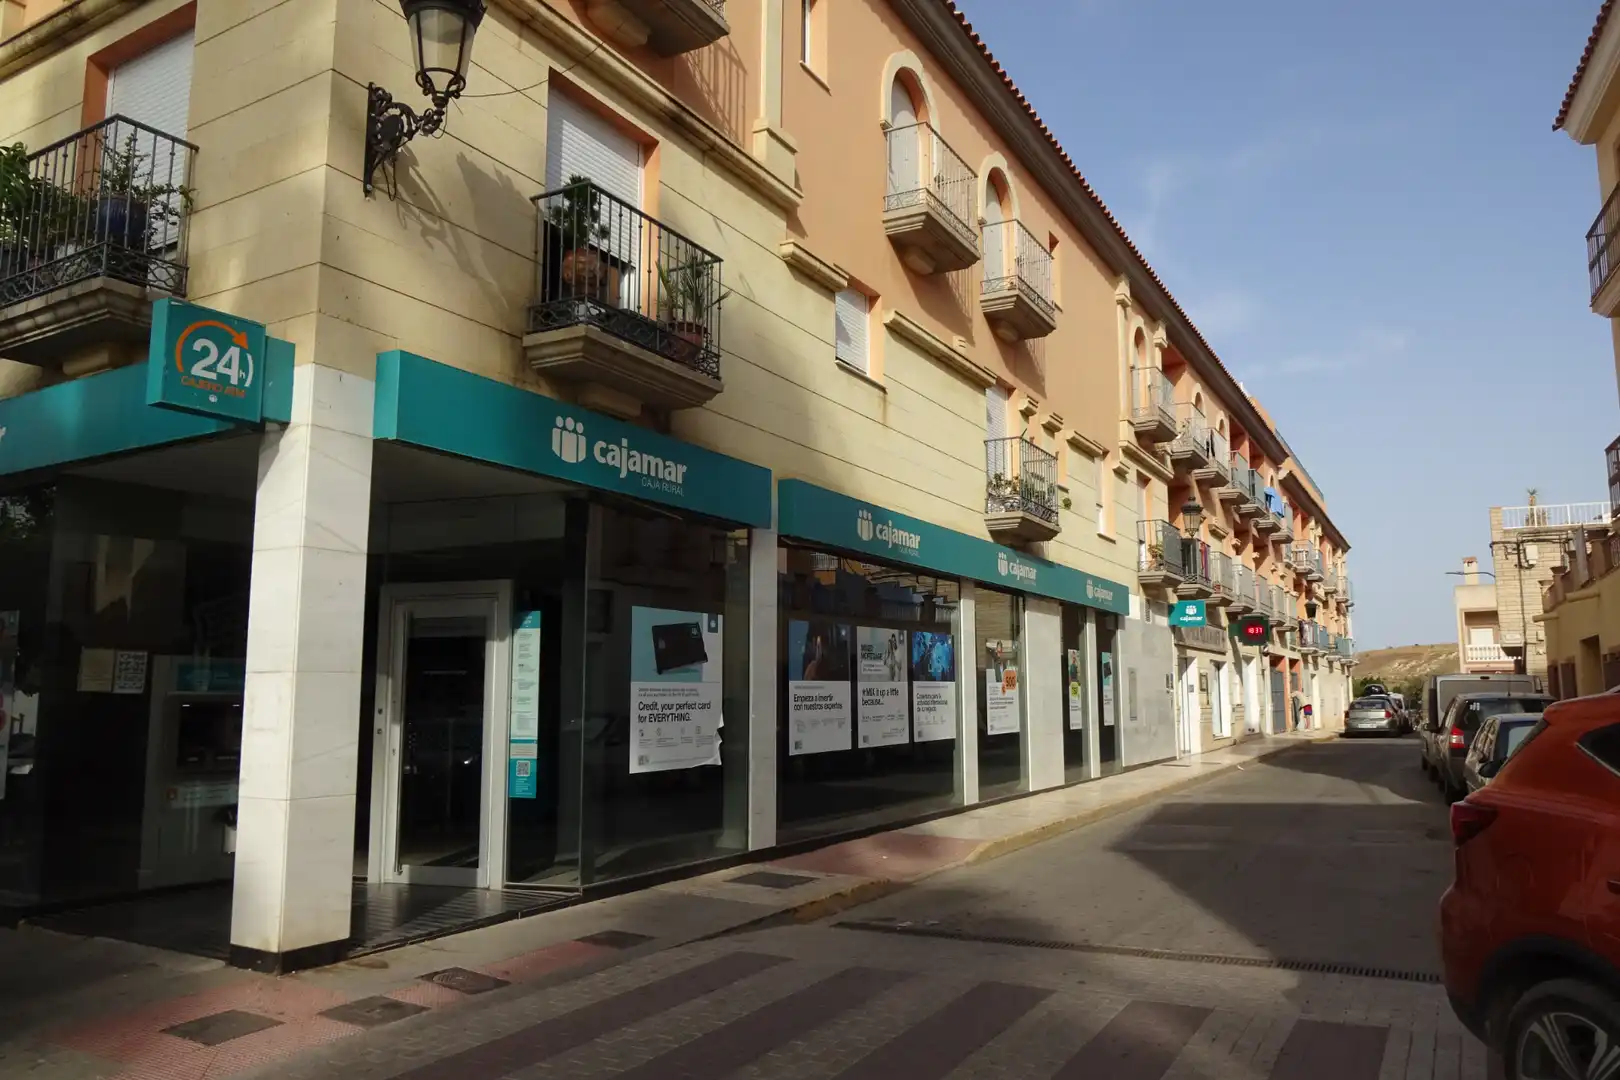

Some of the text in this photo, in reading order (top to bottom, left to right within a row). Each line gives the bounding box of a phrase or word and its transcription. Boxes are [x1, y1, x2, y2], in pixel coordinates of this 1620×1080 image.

[181, 375, 246, 398] CAJERO ATM
[593, 438, 687, 484] cajamar
[641, 476, 685, 497] CAJA RURAL
[876, 519, 920, 550] cajamar
[1009, 559, 1037, 581] cajamar
[1094, 584, 1114, 601] cajamar
[638, 700, 712, 713] Credit, your perfect card
[794, 693, 814, 703] Empieza
[794, 702, 843, 711] con nuestros expertos
[638, 712, 692, 723] for EVERYTHING.
